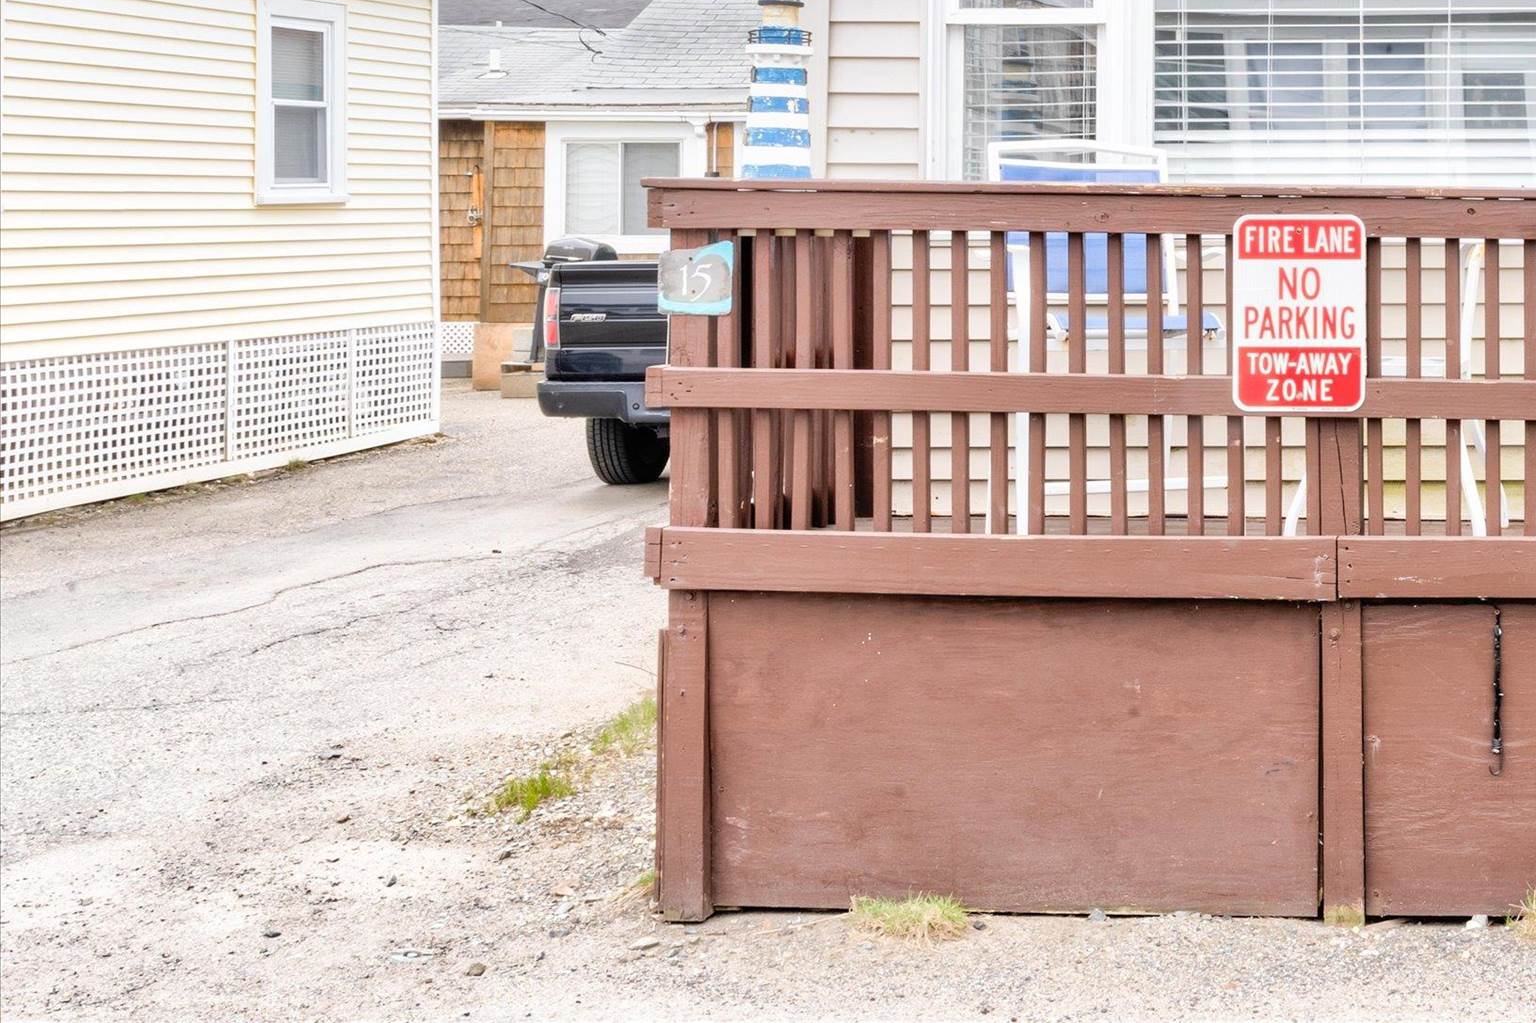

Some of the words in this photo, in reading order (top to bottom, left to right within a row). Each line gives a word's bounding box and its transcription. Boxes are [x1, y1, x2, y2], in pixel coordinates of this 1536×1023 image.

[1244, 226, 1296, 254] FIRE
[1303, 226, 1356, 254] LANE
[679, 263, 713, 302] 15
[1278, 267, 1321, 300] NO
[1244, 306, 1355, 340] PARKING
[1247, 352, 1352, 375] TOW-AWAY
[1265, 379, 1333, 402] ZONE
